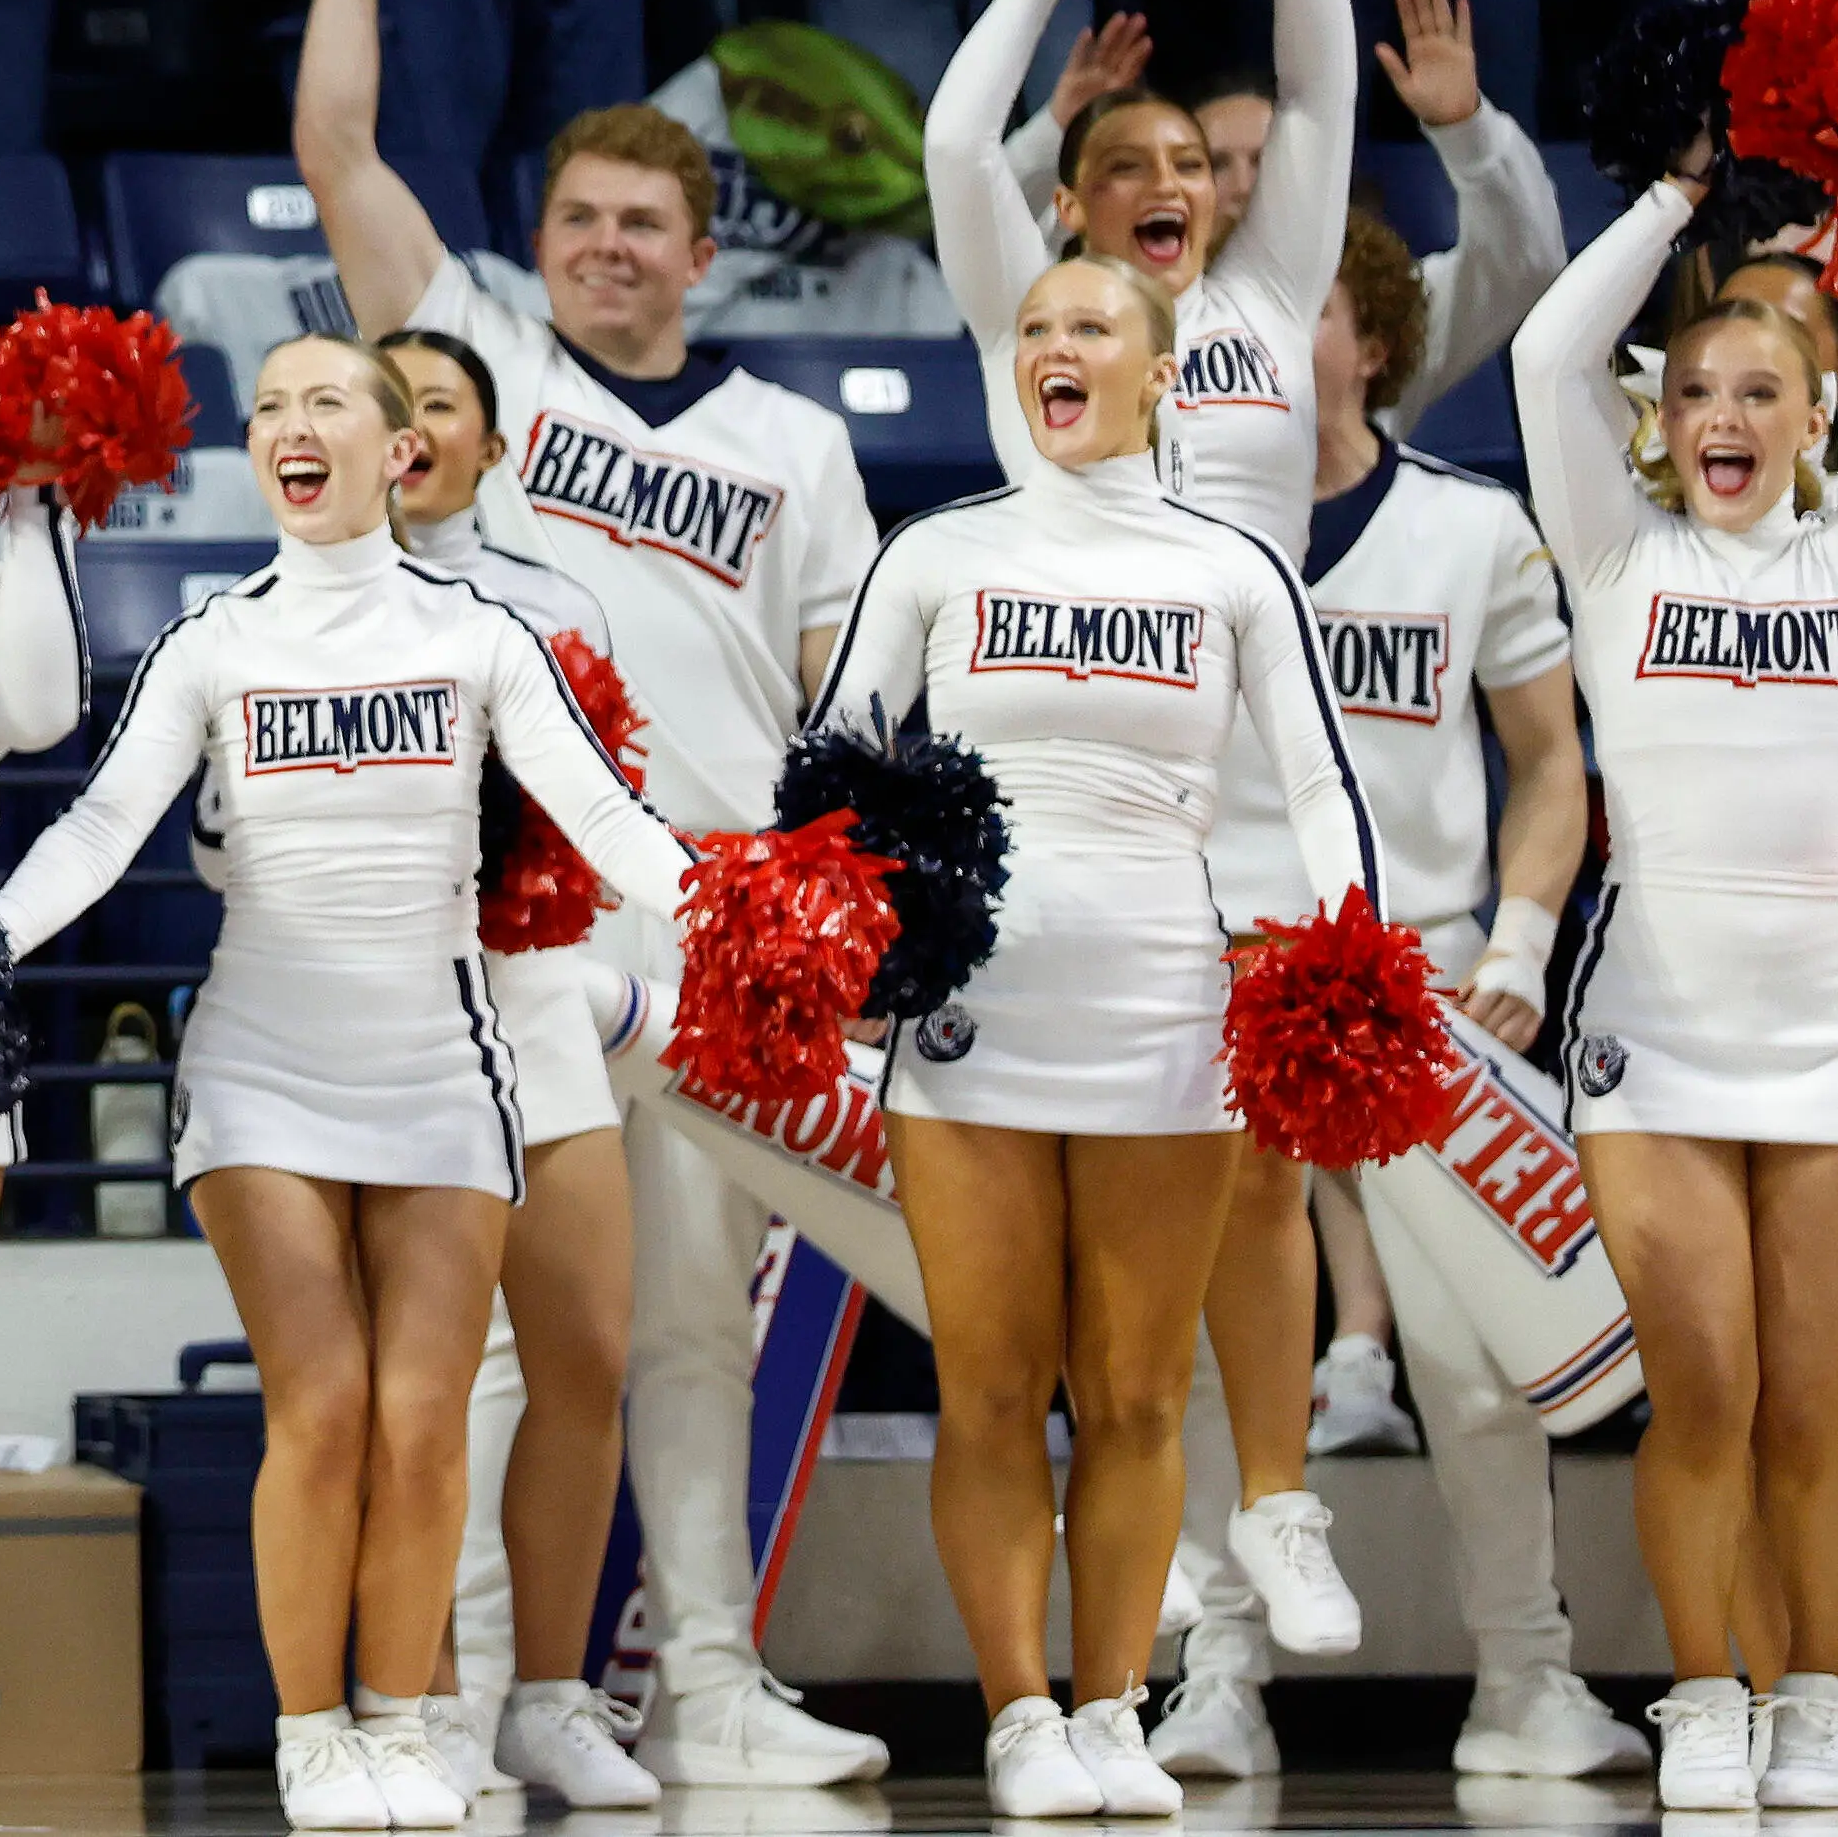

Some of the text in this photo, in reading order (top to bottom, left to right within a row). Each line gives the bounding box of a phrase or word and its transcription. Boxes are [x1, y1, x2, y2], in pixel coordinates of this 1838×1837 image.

[530, 424, 777, 572] BELMONT
[982, 596, 1198, 676] BELMONT
[252, 687, 454, 764] BELMONT
